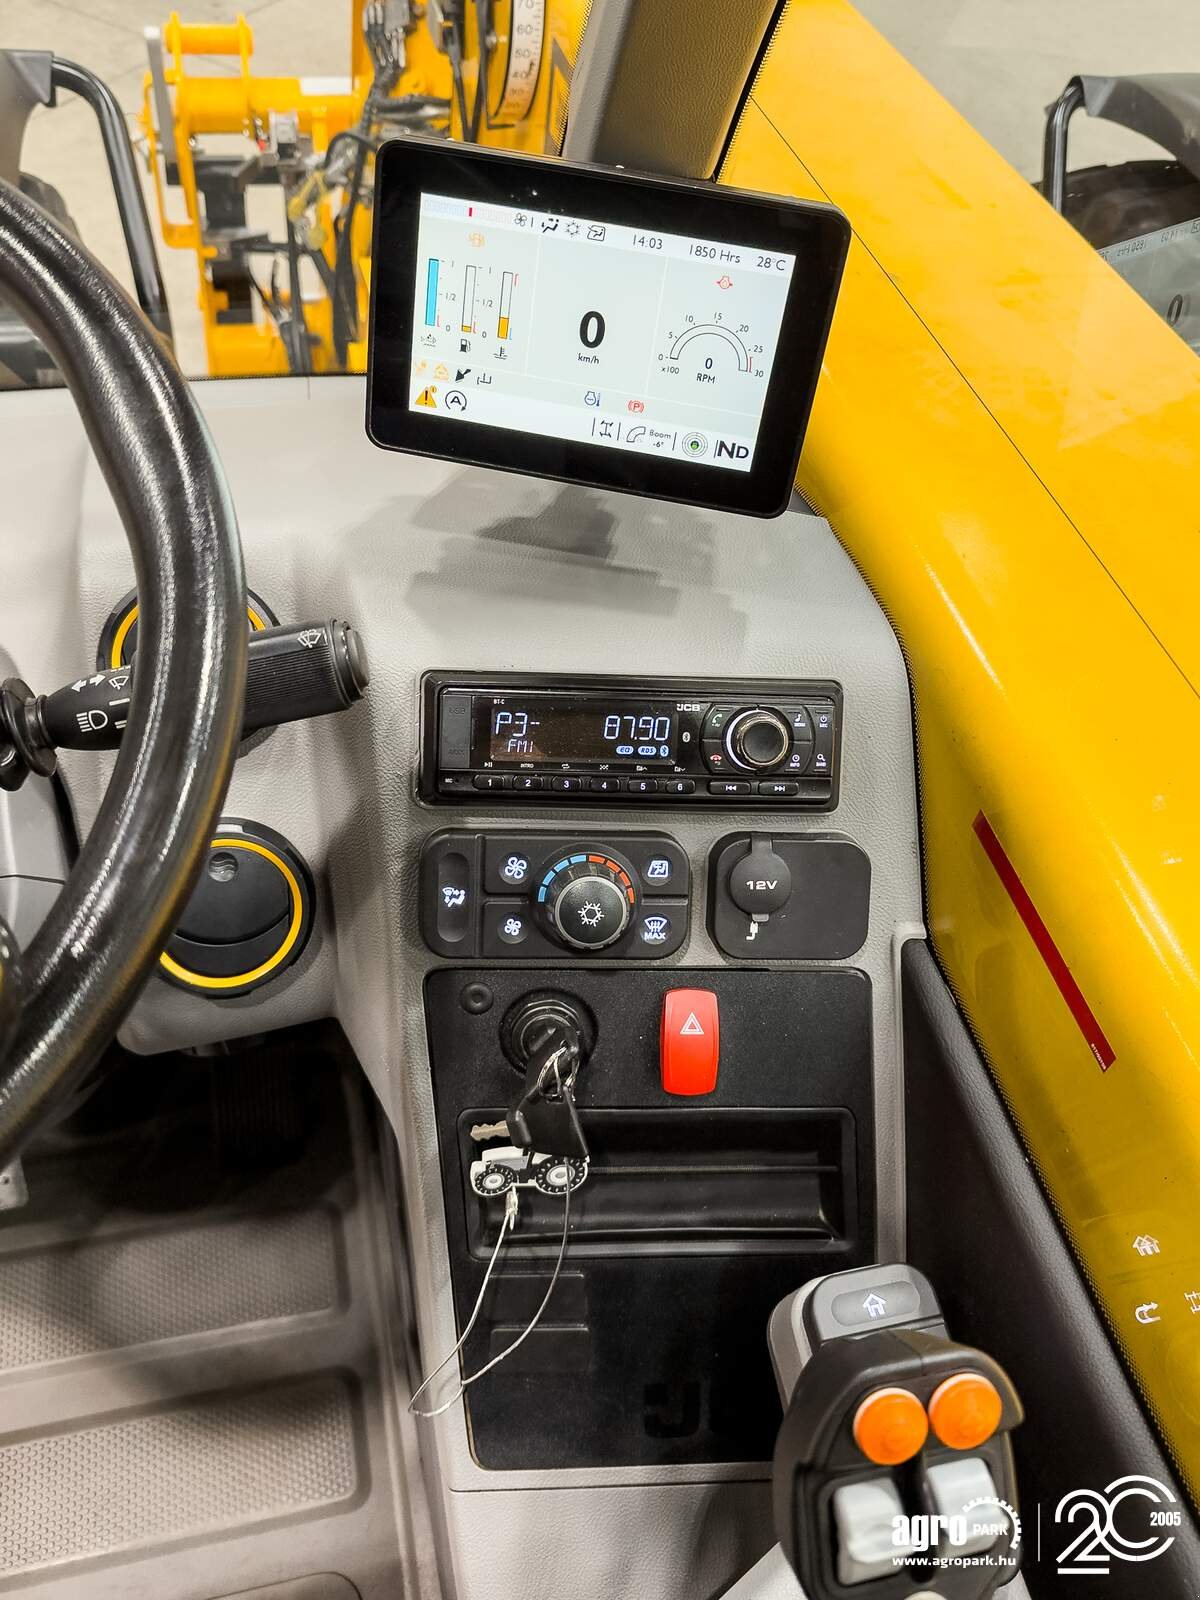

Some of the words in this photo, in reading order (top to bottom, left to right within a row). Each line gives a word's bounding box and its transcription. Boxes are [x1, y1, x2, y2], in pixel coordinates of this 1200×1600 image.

[516, 24, 533, 35] 60
[632, 234, 664, 250] 14:03
[689, 244, 717, 260] 1850
[719, 249, 742, 264] Hrs
[757, 255, 787, 271] 28°C
[445, 292, 457, 302] 1/2
[482, 299, 493, 308] 1/2
[684, 314, 694, 324] 10
[713, 312, 723, 321] 15
[445, 324, 451, 332] 0
[579, 310, 606, 349] 0
[739, 324, 749, 333] 20
[481, 331, 488, 339] 0
[667, 331, 674, 339] 5
[753, 345, 763, 353] 25
[577, 352, 600, 365] km/h
[658, 353, 664, 361] 0
[704, 357, 713, 370] 0
[754, 369, 764, 378] 30
[696, 372, 716, 385] RPM
[649, 429, 672, 440] Boom
[717, 440, 749, 460] ND
[676, 703, 701, 712] JCB
[603, 715, 671, 742] 87.90
[640, 747, 655, 755] RDS
[487, 778, 493, 787] 1
[525, 779, 532, 787] 2
[563, 780, 570, 788] 3
[601, 781, 607, 790] 4
[639, 782, 646, 791] 5
[677, 783, 683, 792] 6
[746, 880, 778, 890] 12V
[644, 931, 666, 941] MAX
